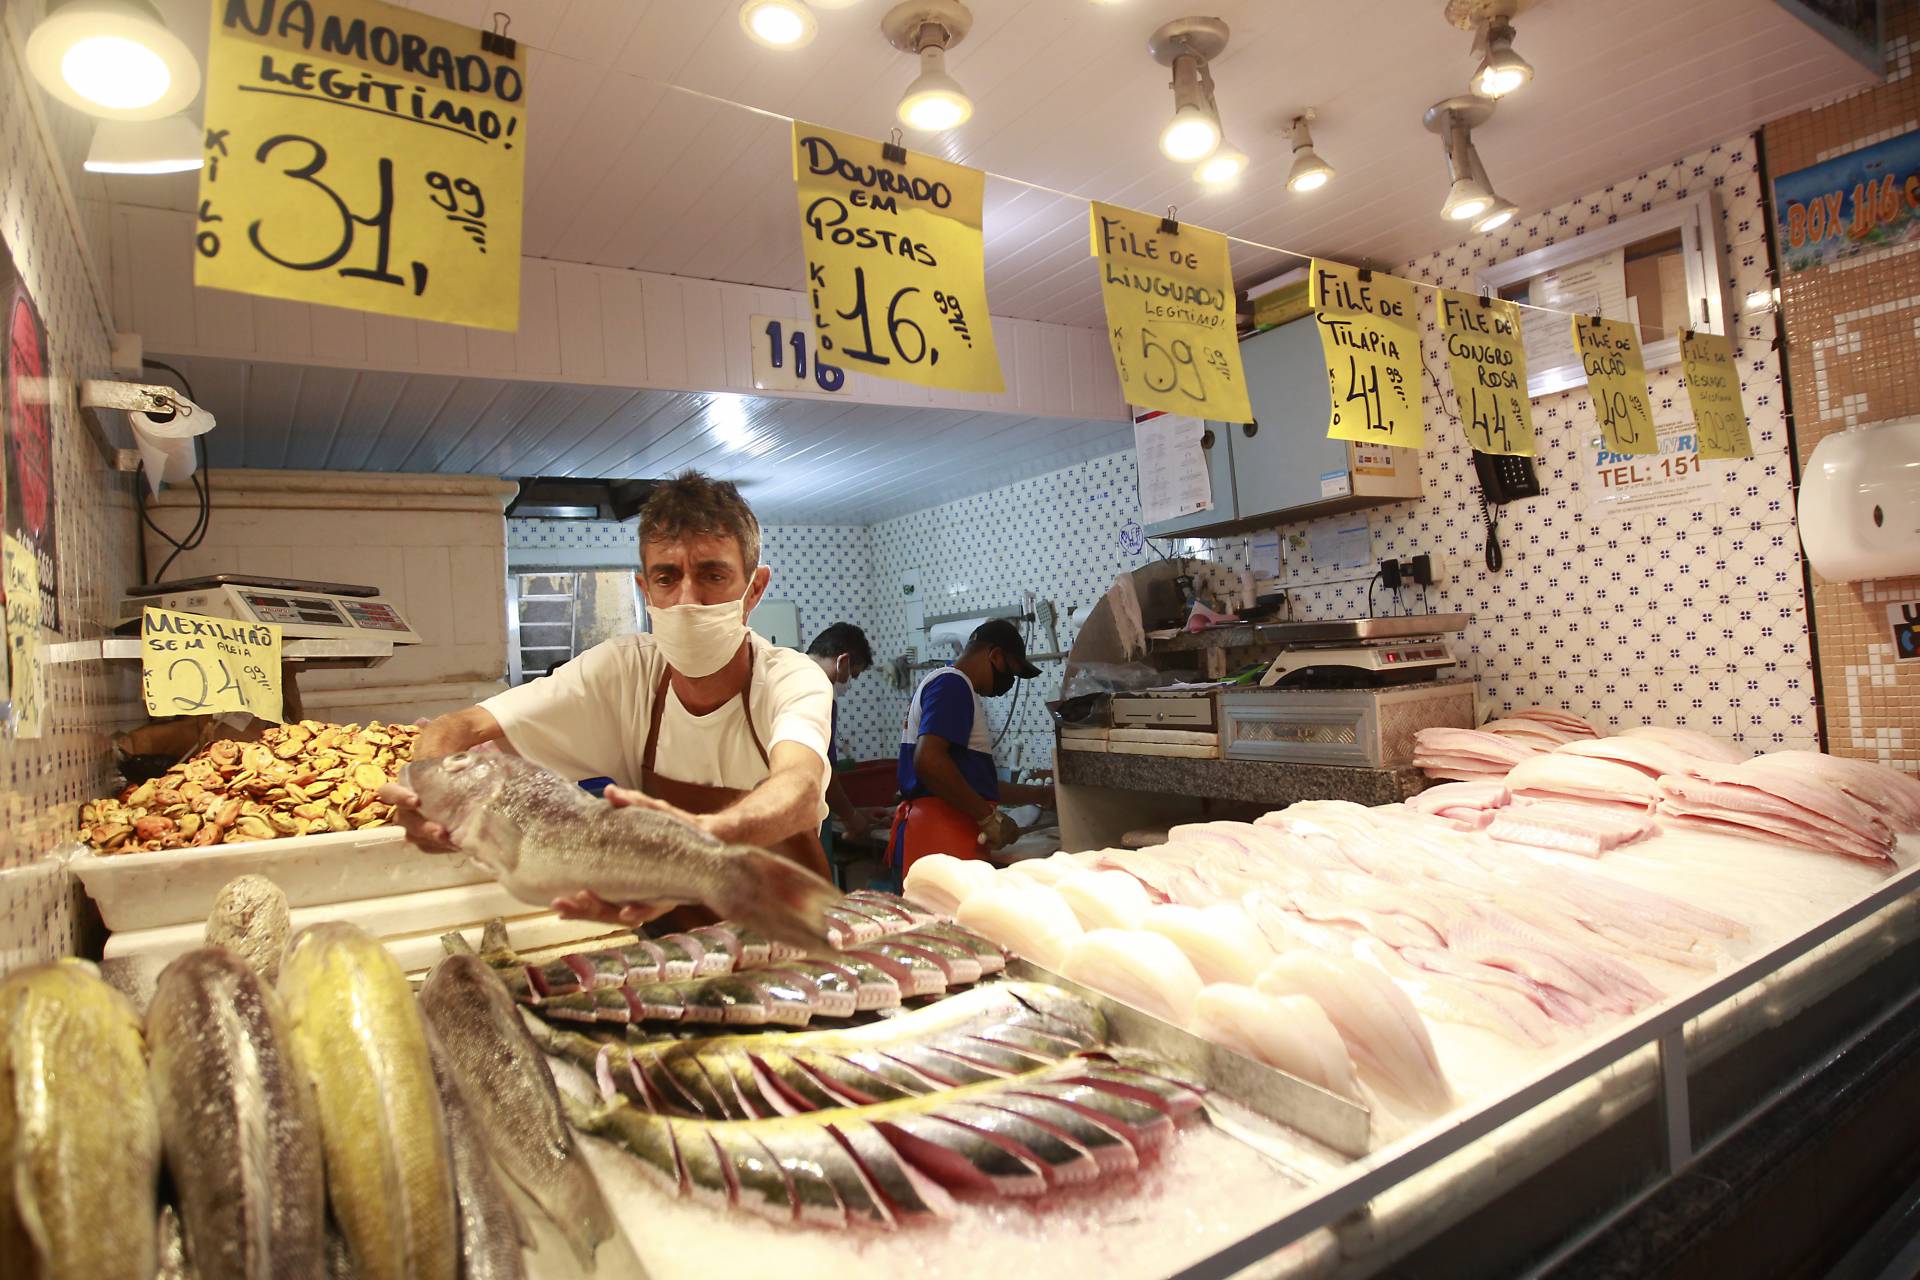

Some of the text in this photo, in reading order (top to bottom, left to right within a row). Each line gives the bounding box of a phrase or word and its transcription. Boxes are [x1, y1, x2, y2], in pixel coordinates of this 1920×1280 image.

[223, 0, 523, 102] NAMORADO
[800, 136, 951, 209] DOURADO
[850, 189, 898, 215] EM
[1787, 190, 1844, 249] BOX
[1847, 172, 1901, 240] 116
[806, 196, 937, 266] POSTAS
[1169, 250, 1199, 270] DE
[809, 262, 833, 350] KILO
[1380, 300, 1403, 317] DE
[1494, 318, 1512, 336] DE
[766, 321, 845, 392] 116
[1448, 333, 1513, 366] CONGRO
[1583, 351, 1627, 381] CAÇÃO
[1478, 364, 1519, 390] ROSA
[1598, 465, 1652, 488] TEL:
[1660, 454, 1701, 477] 151
[145, 613, 272, 646] MEXILHÃO
[149, 639, 204, 651] SEM
